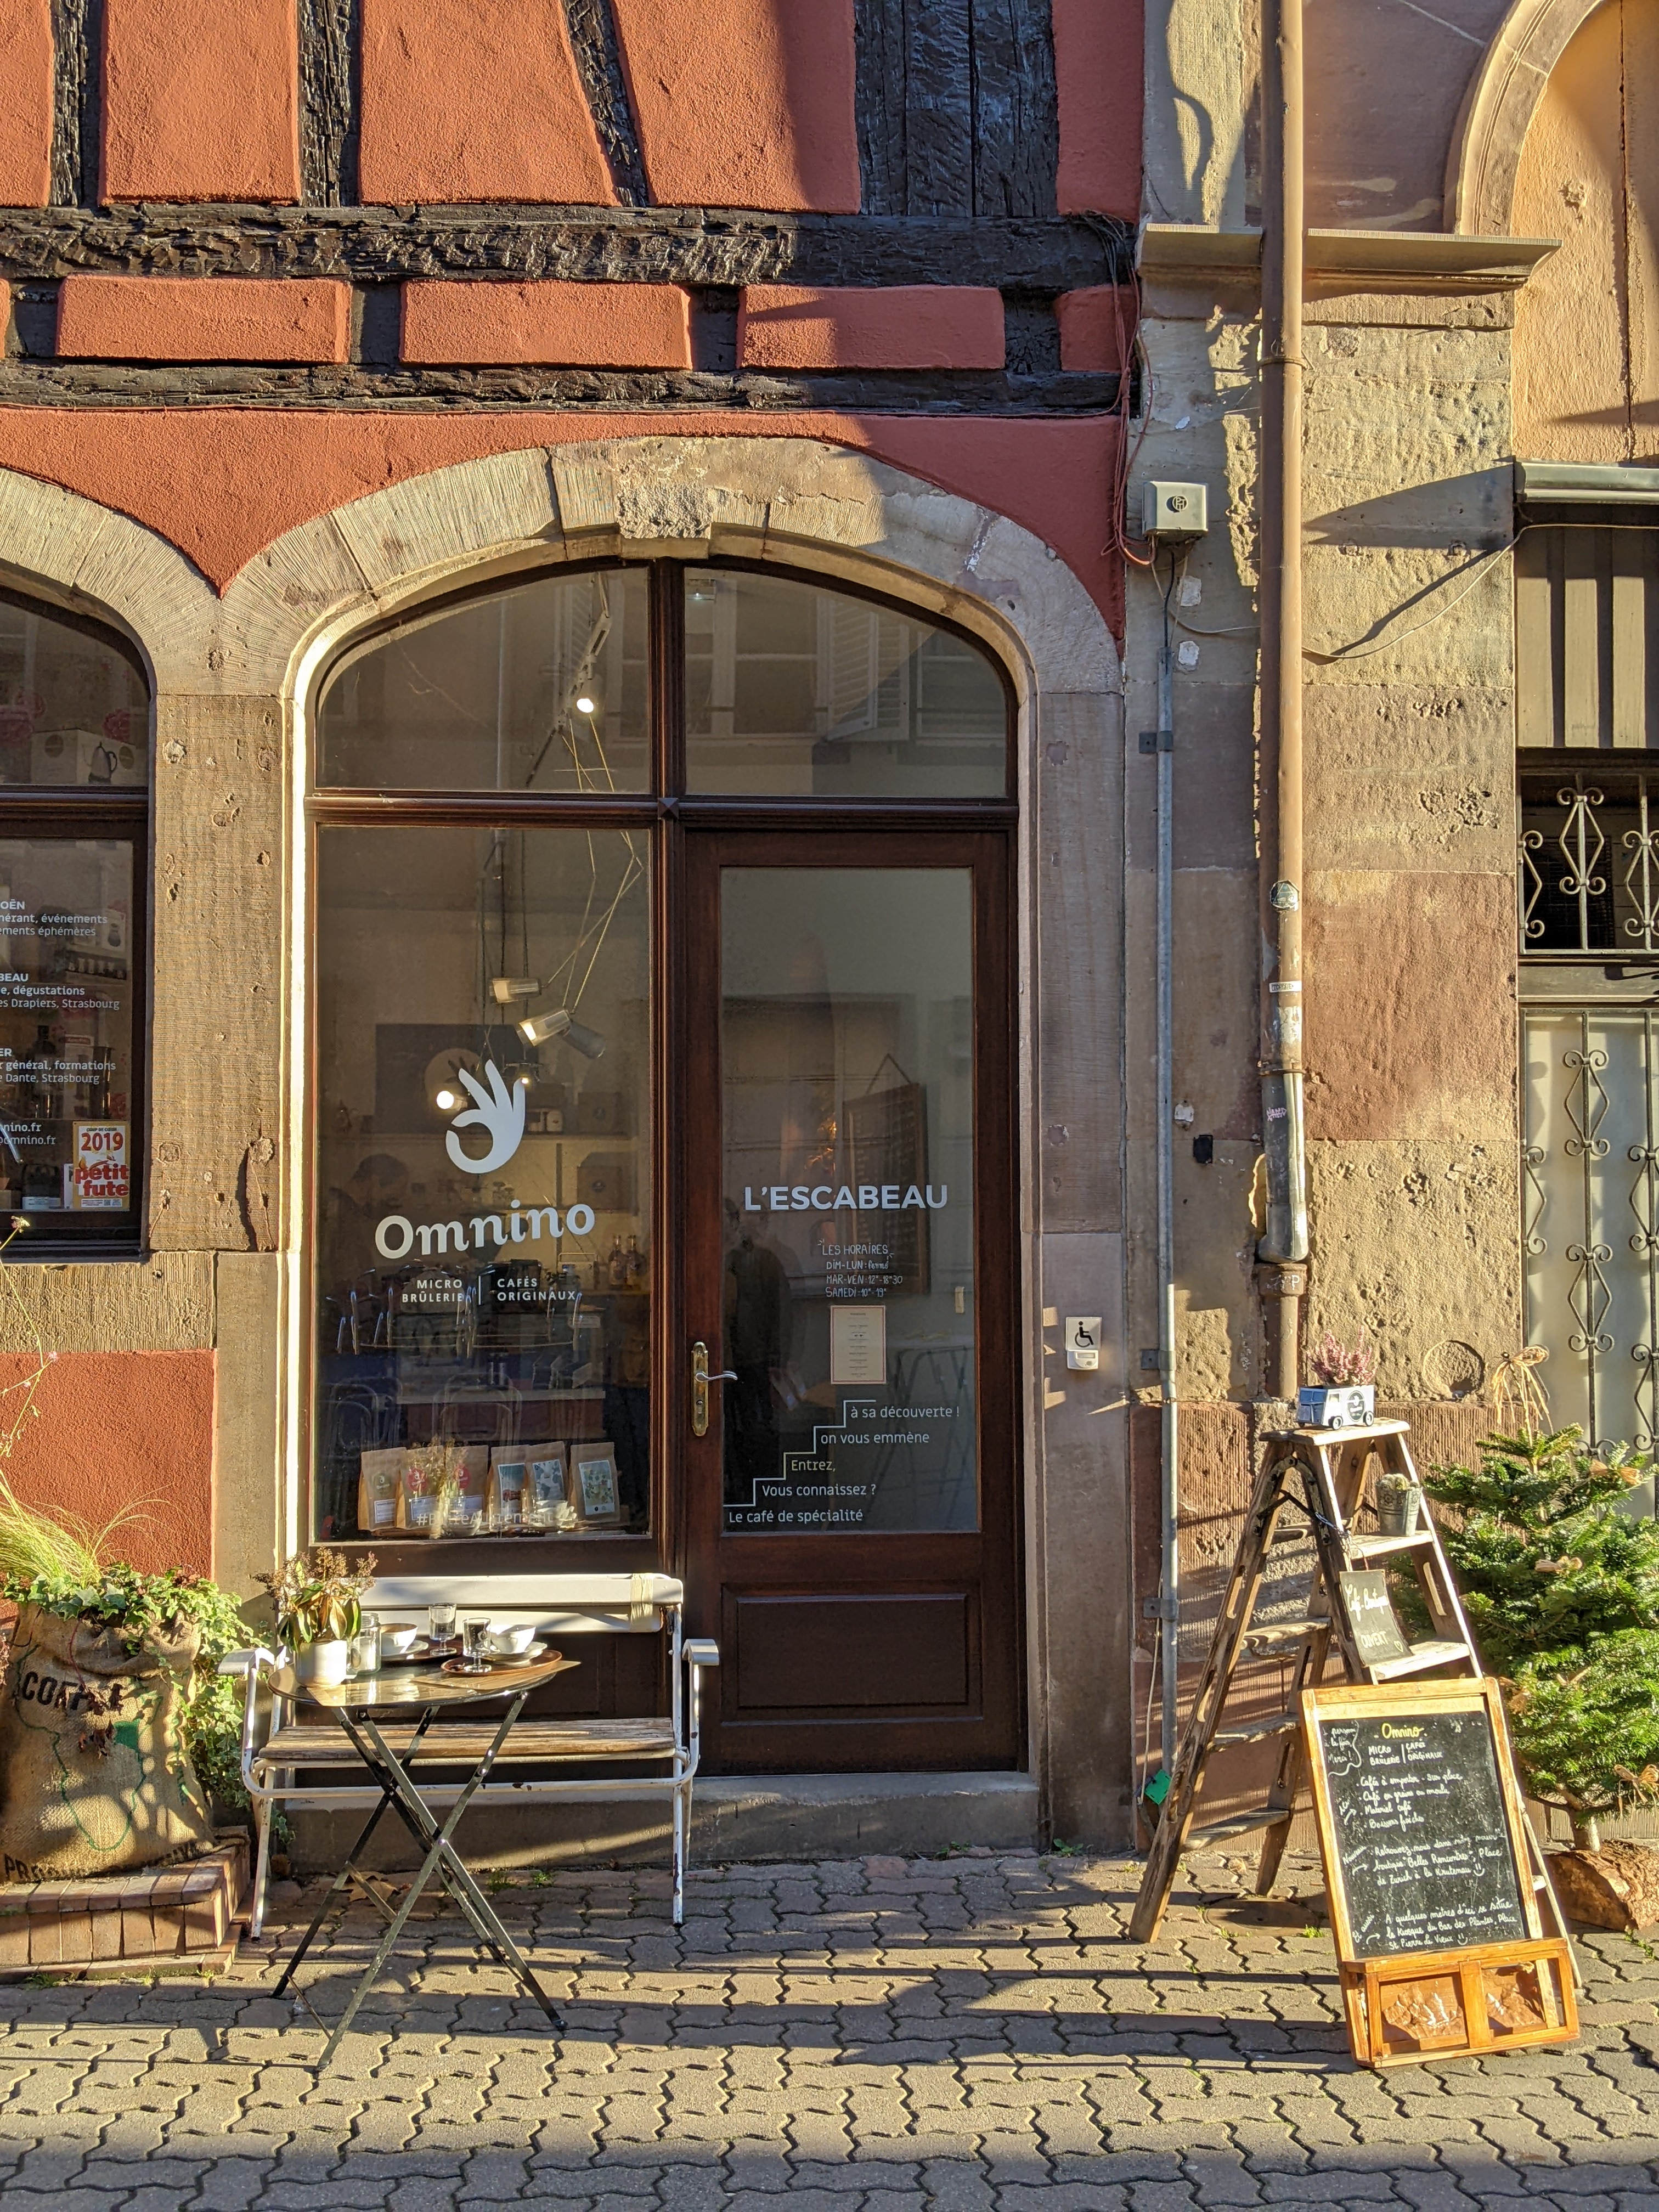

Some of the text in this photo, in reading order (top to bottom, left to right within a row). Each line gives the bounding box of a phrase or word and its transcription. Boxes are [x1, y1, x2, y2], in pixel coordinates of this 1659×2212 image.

[41, 913, 108, 924] événements
[38, 926, 96, 937] éphémères
[13, 985, 85, 997] dégustations
[12, 998, 59, 1009] Drapiers,
[62, 998, 120, 1010] Strasbourg
[6, 1060, 52, 1071] général,
[55, 1060, 116, 1070] formations
[6, 1073, 39, 1083] Dante,
[42, 1074, 100, 1084] Strasbourg
[81, 1132, 123, 1151] 2019
[75, 1163, 129, 1184] petit
[744, 1184, 948, 1210] L'ESCABEAU
[375, 1199, 595, 1259] Omnino
[822, 1243, 888, 1255] LES HORAIRES
[417, 1279, 462, 1289] MICRO
[497, 1276, 538, 1288] CAFÉS
[402, 1291, 464, 1303] BRÛLERIE
[497, 1291, 576, 1301] ORIGINAUX
[851, 1406, 858, 1418] à
[862, 1408, 876, 1418] sa
[880, 1406, 952, 1418] découverte
[821, 1431, 929, 1444] on vous emmène
[791, 1459, 836, 1472] Entrez,
[762, 1485, 793, 1496] Vous
[796, 1483, 867, 1496] connaissez
[729, 1509, 863, 1524] Le café de spécialité
[1382, 1723, 1424, 1739] Omnino
[1368, 1746, 1392, 1756] MICRO
